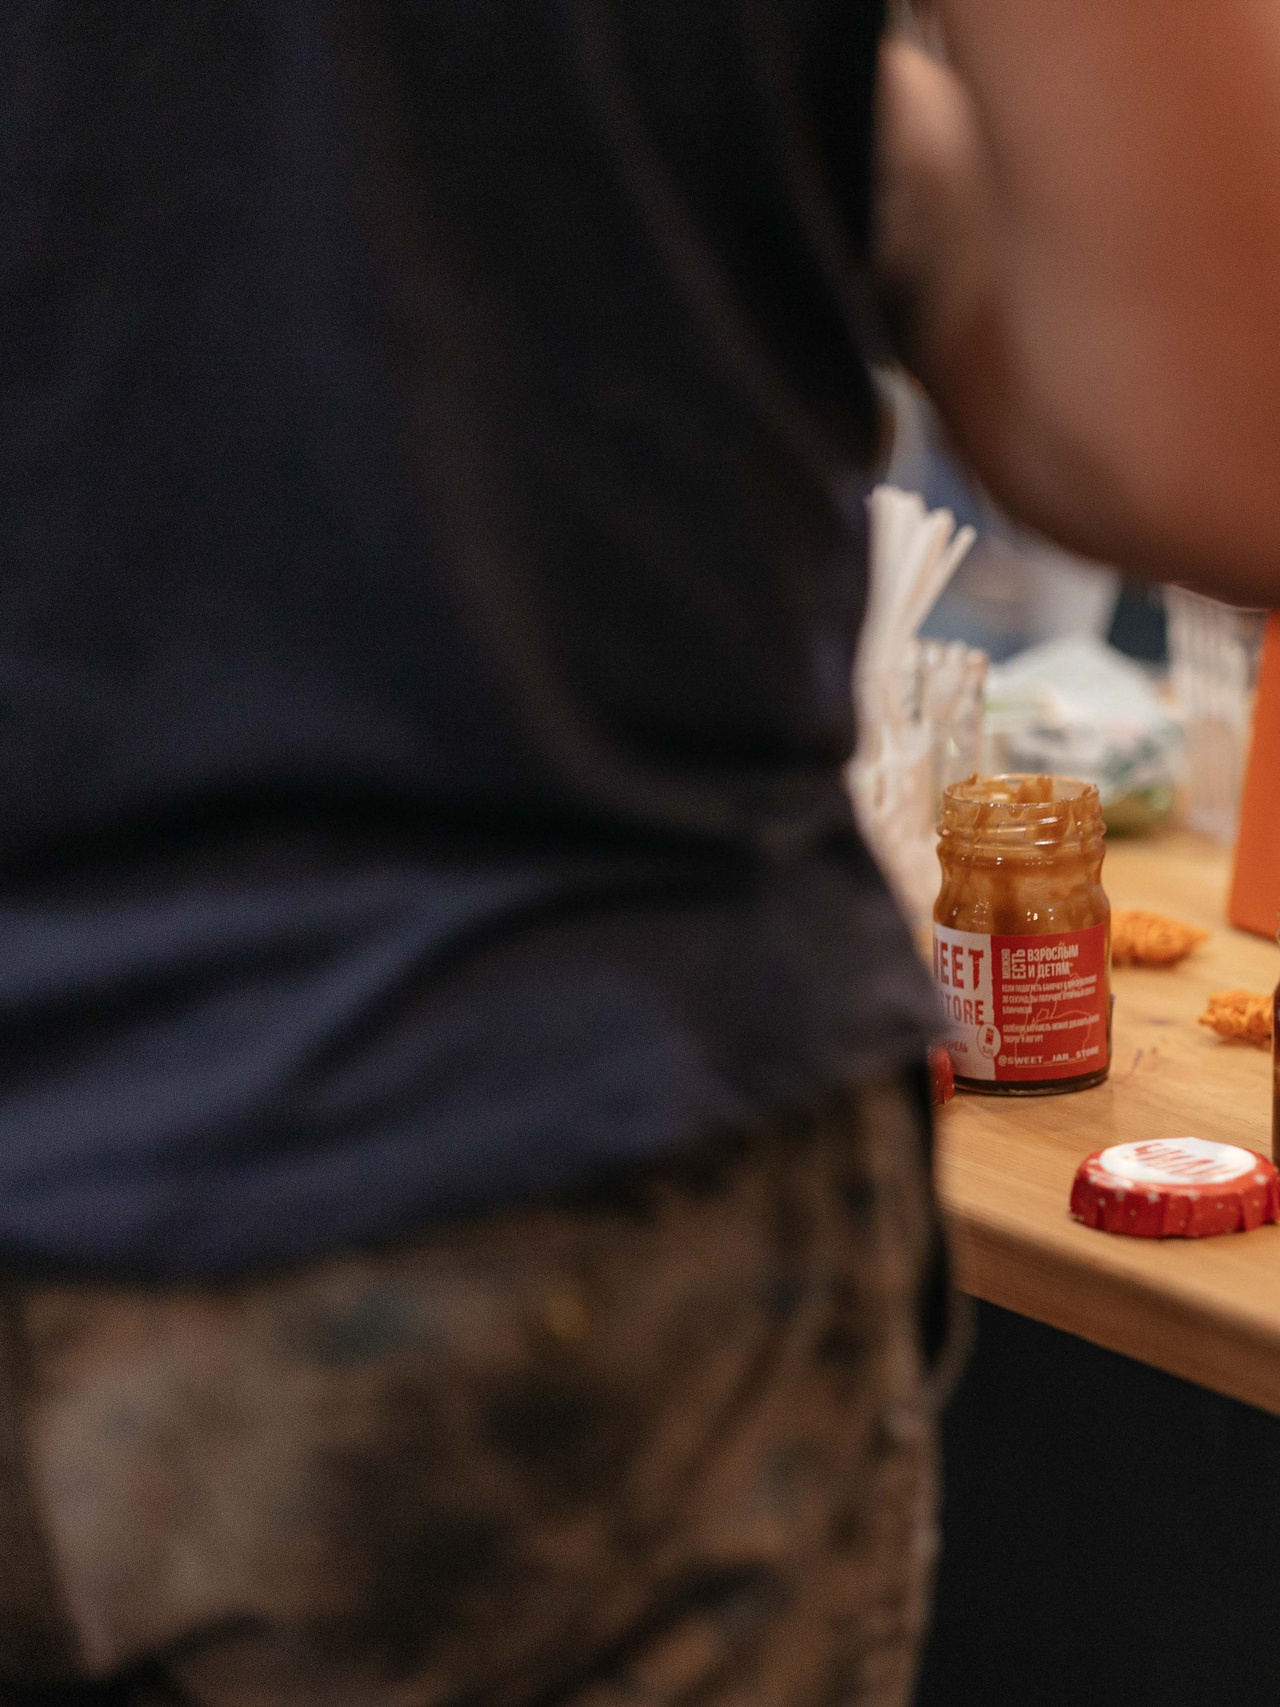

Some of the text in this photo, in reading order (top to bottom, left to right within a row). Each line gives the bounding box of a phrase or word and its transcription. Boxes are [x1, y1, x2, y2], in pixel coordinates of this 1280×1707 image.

[1027, 944, 1079, 962] ВЗРОСЛЫМ
[1011, 949, 1026, 979] ЕСТЬ
[1027, 964, 1036, 978] И
